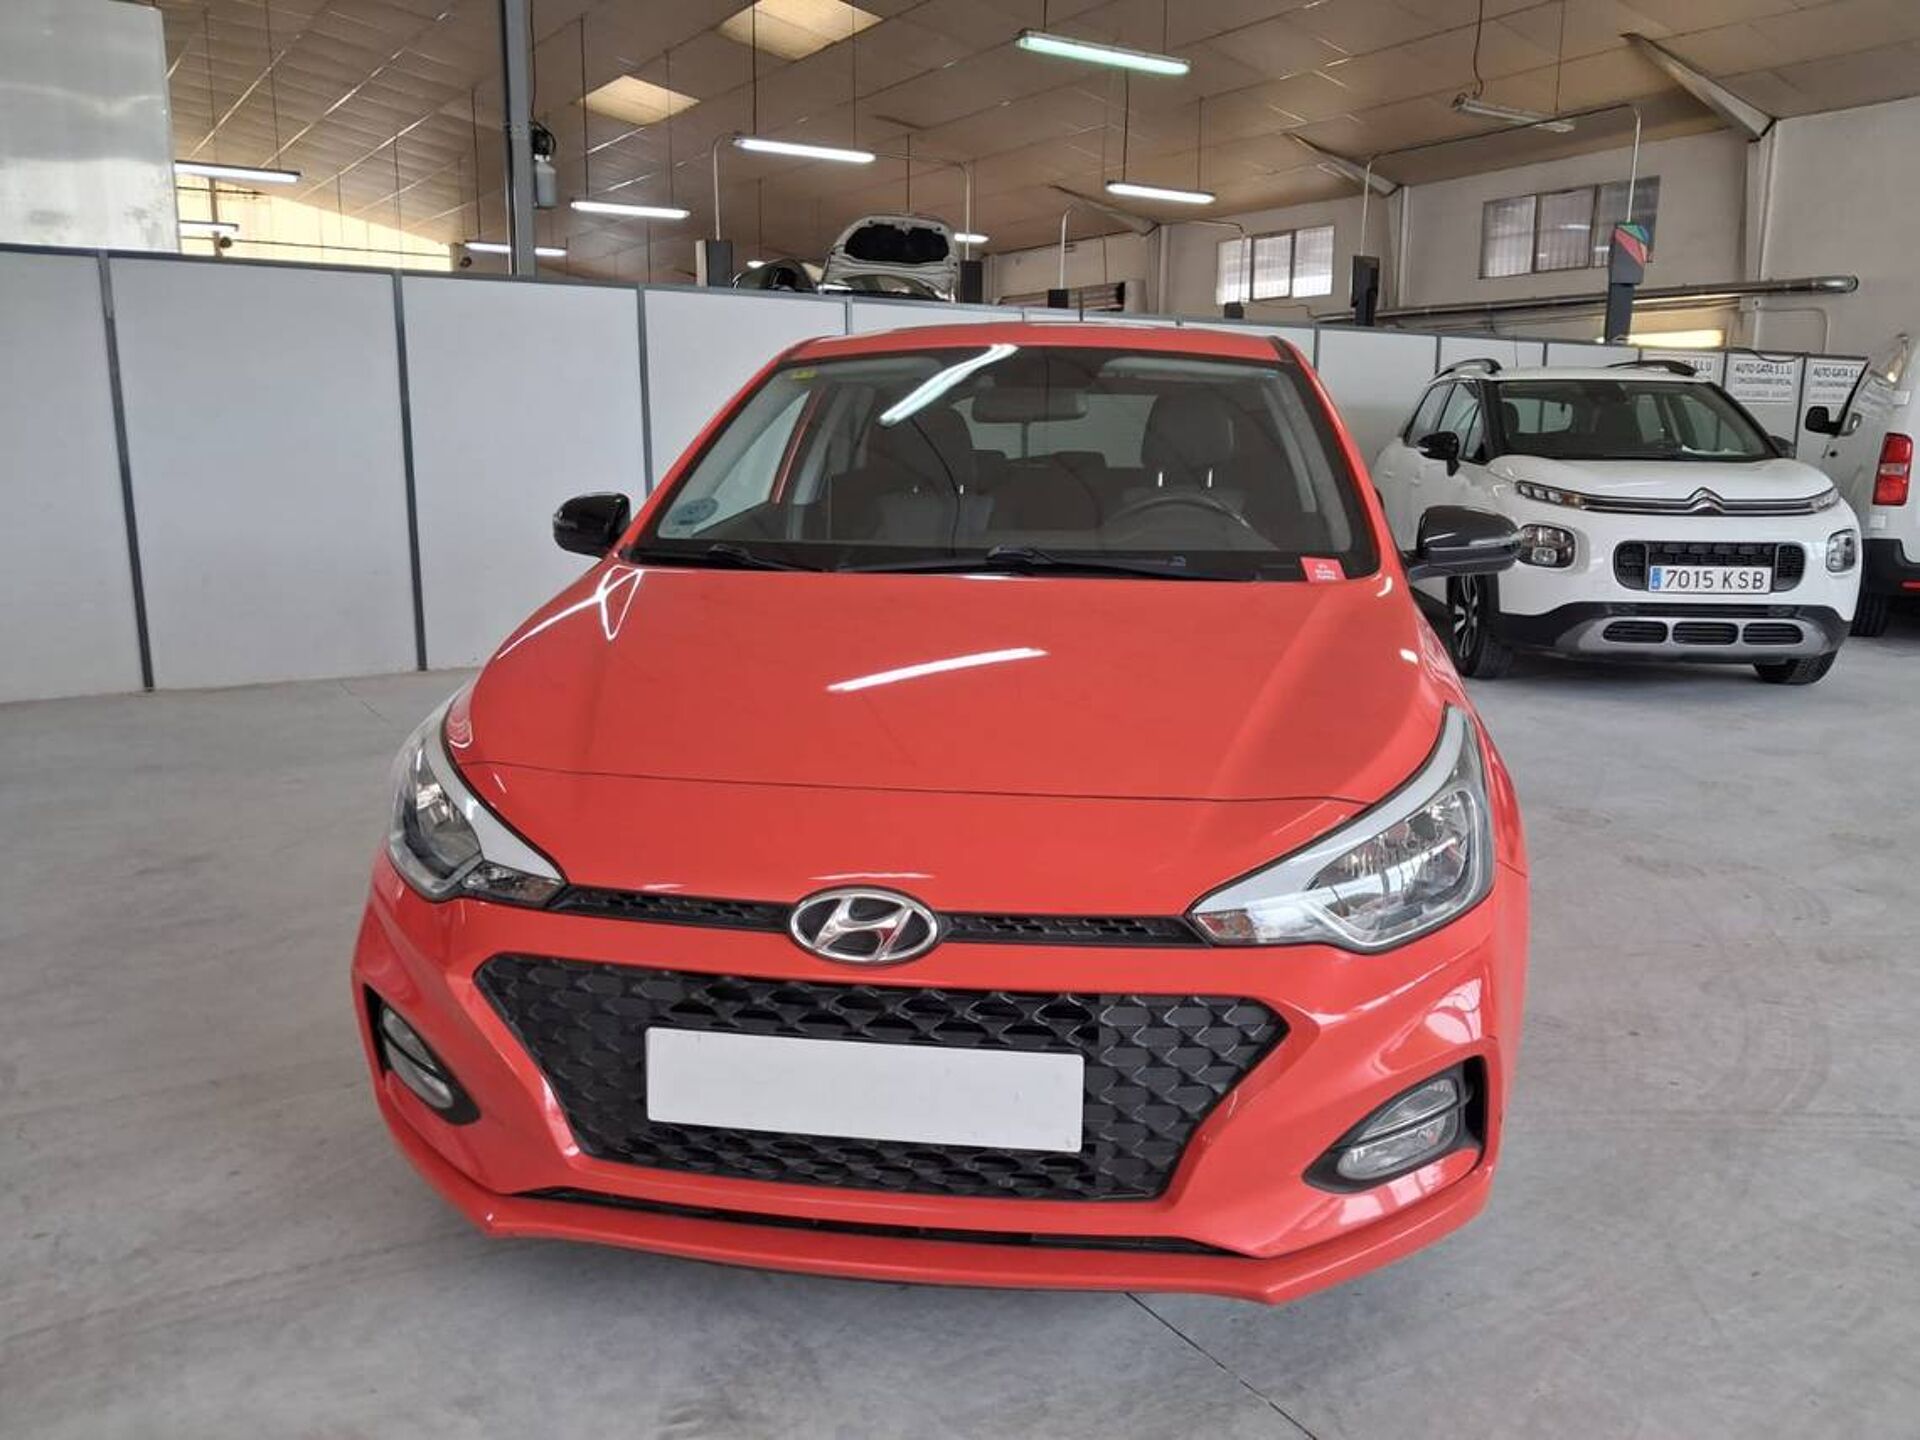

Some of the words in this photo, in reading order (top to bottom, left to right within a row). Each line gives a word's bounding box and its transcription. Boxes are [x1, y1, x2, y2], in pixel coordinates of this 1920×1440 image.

[1735, 363, 1755, 374] AUTO
[1813, 366, 1831, 378] AUTO
[1666, 569, 1714, 589] 7015
[1722, 570, 1765, 590] KSB
